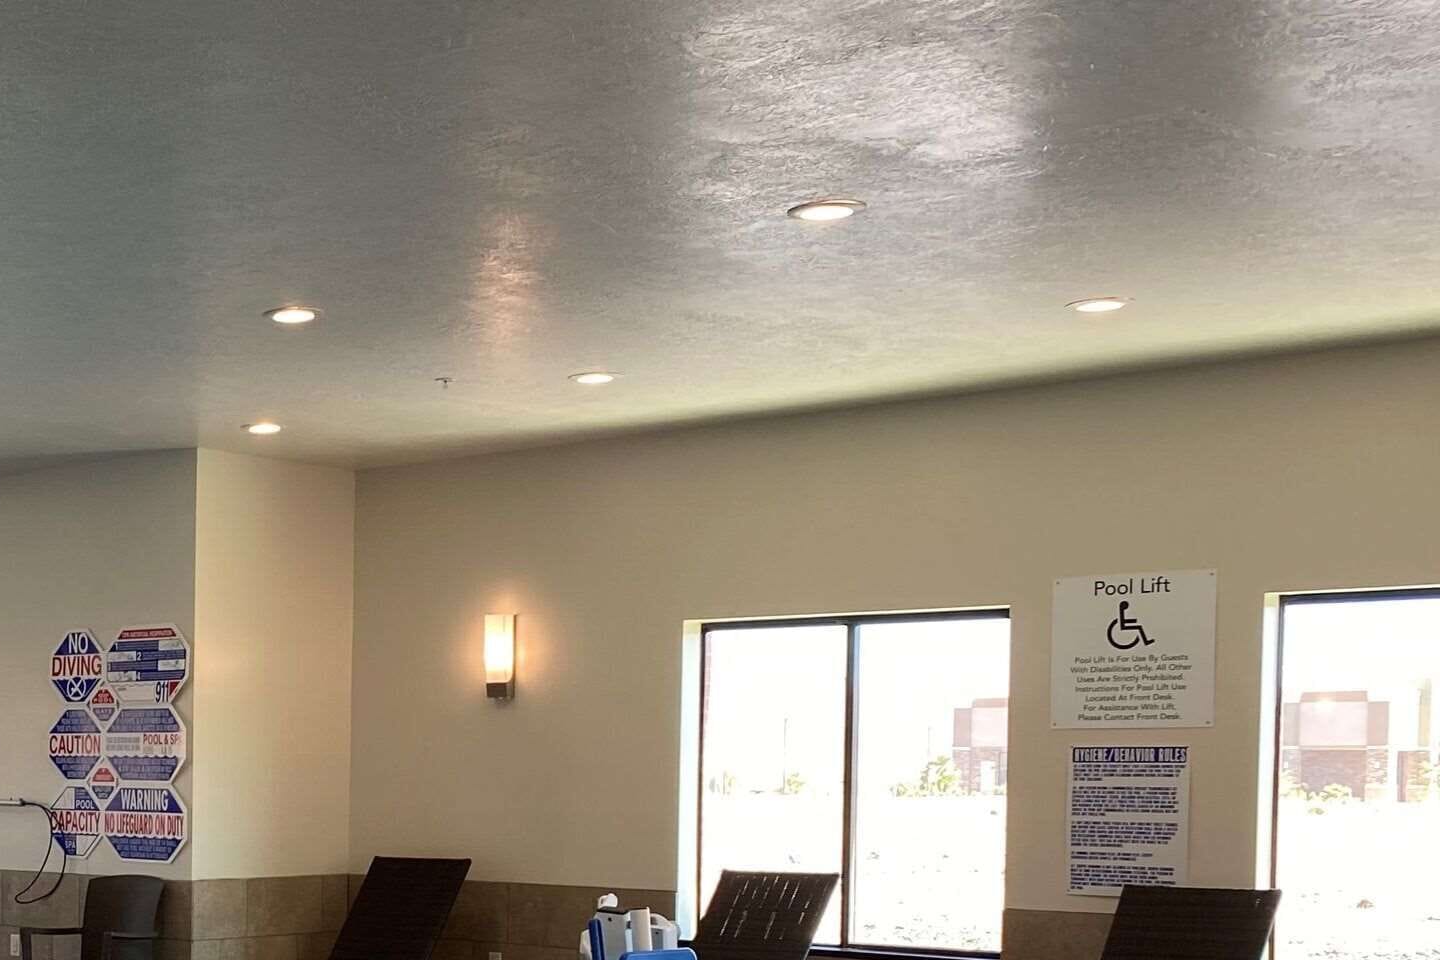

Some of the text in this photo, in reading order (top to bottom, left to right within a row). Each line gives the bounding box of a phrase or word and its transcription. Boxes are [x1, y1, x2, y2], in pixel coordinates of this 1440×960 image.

[1094, 576, 1171, 596] Pool Lift
[68, 632, 89, 654] NO
[51, 654, 102, 677] DIVING
[1075, 656, 1092, 664] Pool
[1148, 655, 1158, 663] By
[1113, 675, 1139, 683] Strictly
[155, 682, 169, 704] 911
[49, 735, 100, 754] CAUTION
[143, 734, 163, 745] POOL
[164, 734, 169, 744] &
[1159, 748, 1187, 762] RULES
[75, 799, 95, 809] POOL
[121, 790, 168, 811] WARNING
[51, 811, 100, 831] CAPACITY
[104, 814, 184, 837] NO LIFEGUARD ON DUTY
